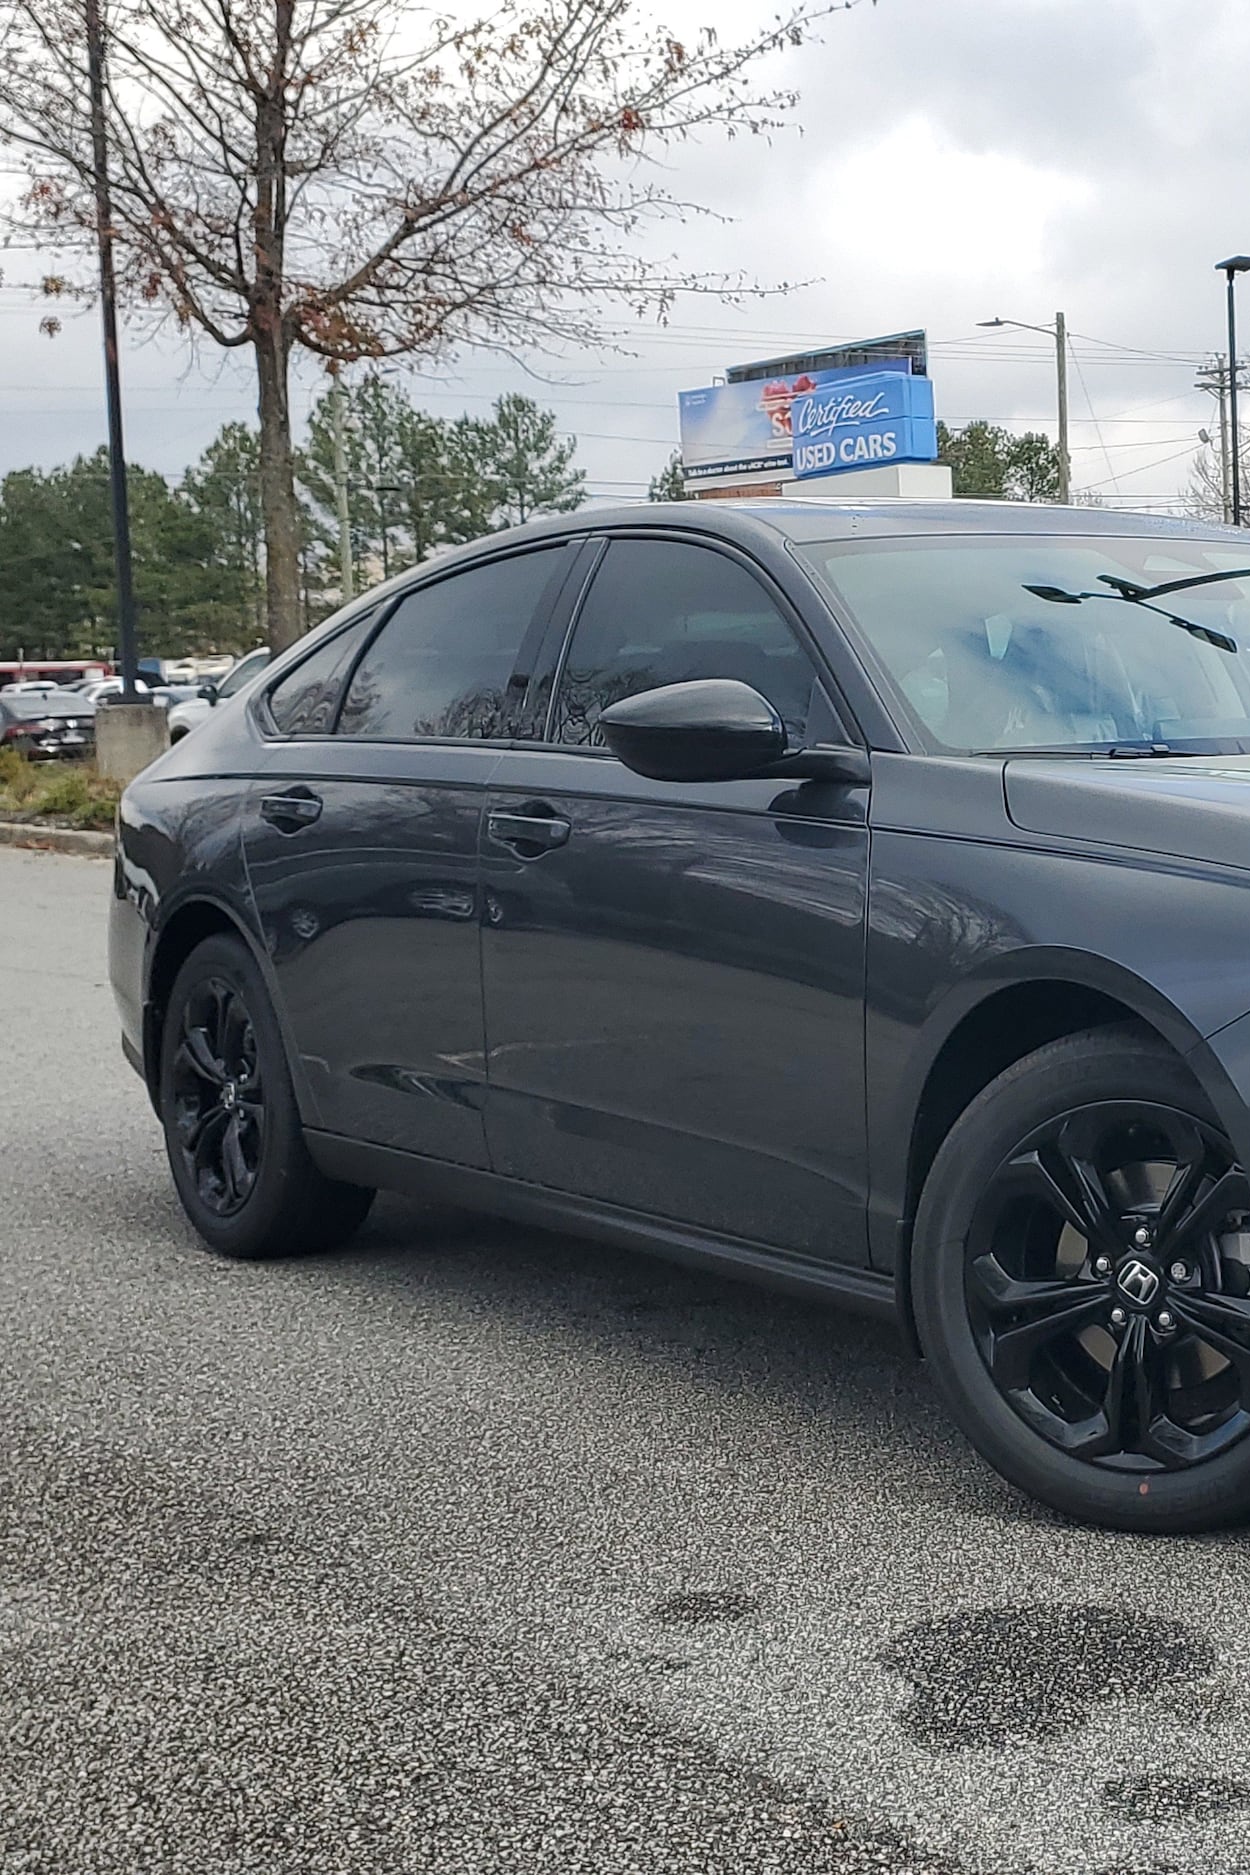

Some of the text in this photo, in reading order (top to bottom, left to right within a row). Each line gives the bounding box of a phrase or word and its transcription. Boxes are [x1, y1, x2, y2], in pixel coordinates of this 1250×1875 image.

[799, 392, 889, 436] Certified
[796, 432, 897, 471] USED CARS
